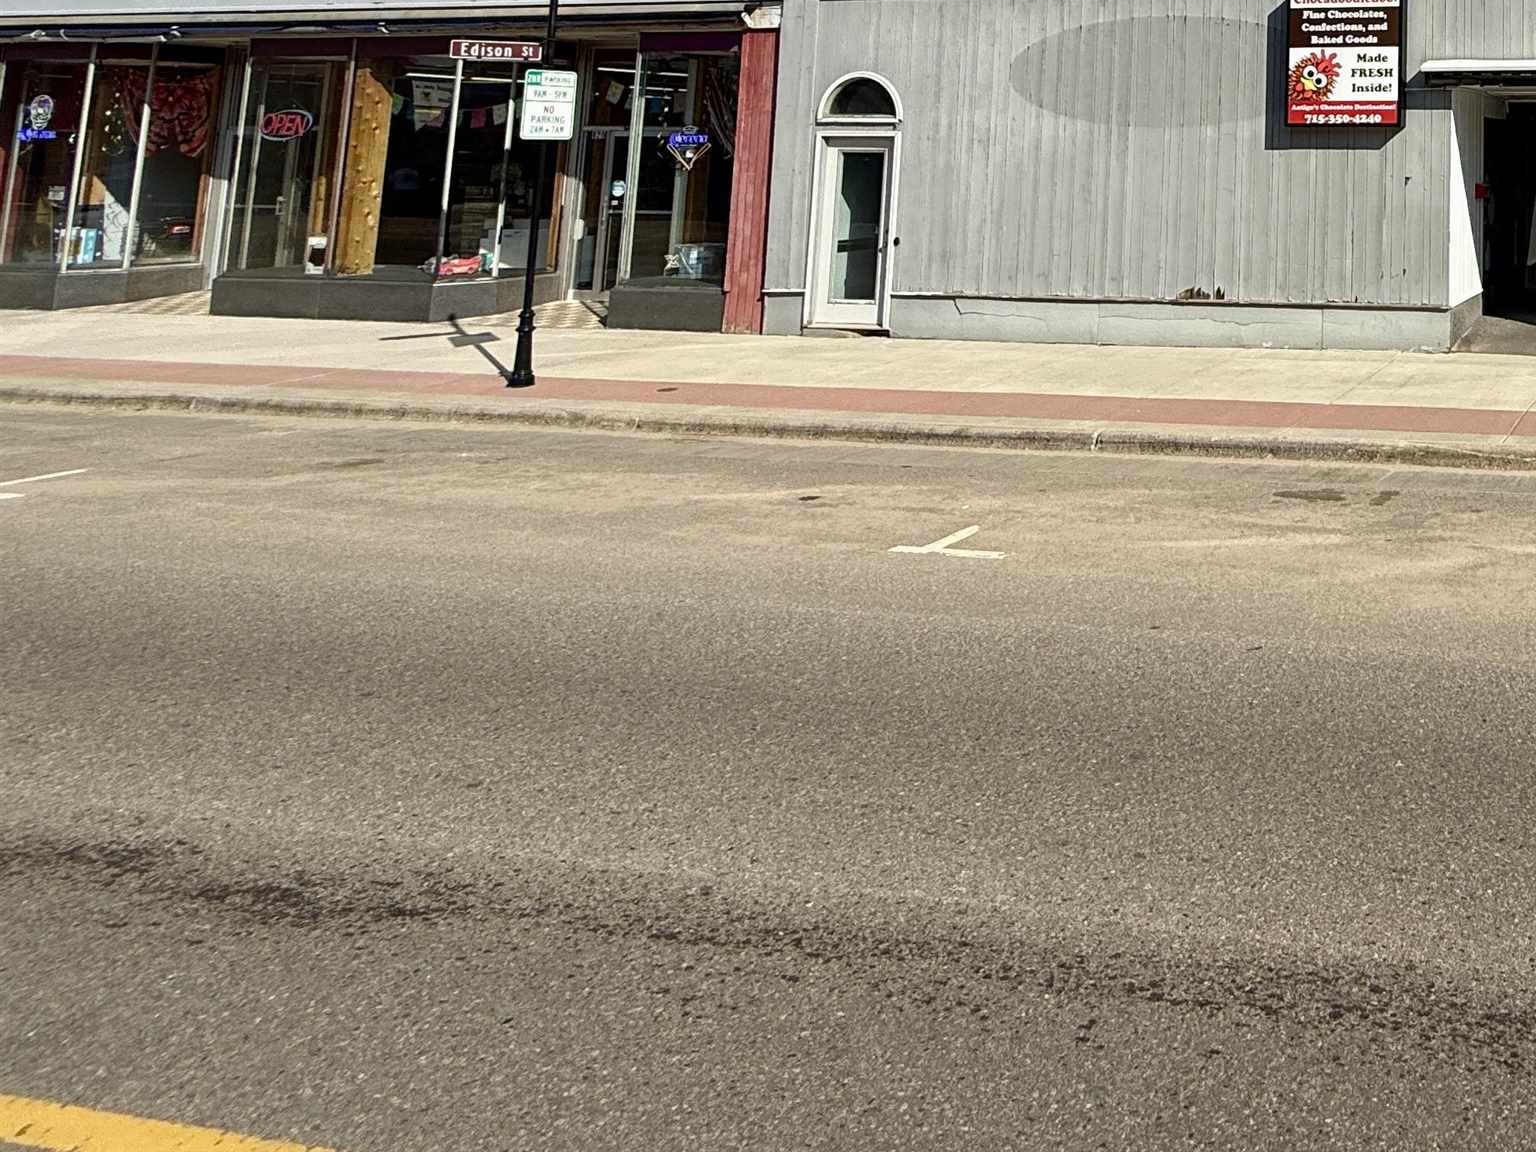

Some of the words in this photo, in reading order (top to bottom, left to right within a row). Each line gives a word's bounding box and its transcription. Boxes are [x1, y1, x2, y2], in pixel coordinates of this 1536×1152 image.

[1302, 10, 1326, 19] Fine
[1327, 10, 1387, 19] Chocolates,
[1301, 23, 1366, 32] Confections,
[1367, 22, 1388, 31] and
[1311, 35, 1343, 44] Baked
[1345, 34, 1378, 43] Goods
[460, 42, 513, 57] Edison
[521, 46, 533, 56] St
[1357, 53, 1388, 62] Made
[1351, 68, 1393, 77] FRESH
[1351, 83, 1392, 92] Inside!
[543, 105, 555, 114] NO
[530, 115, 566, 124] PARKING
[1304, 114, 1382, 124] 715-350-4240
[262, 112, 307, 136] OPEN
